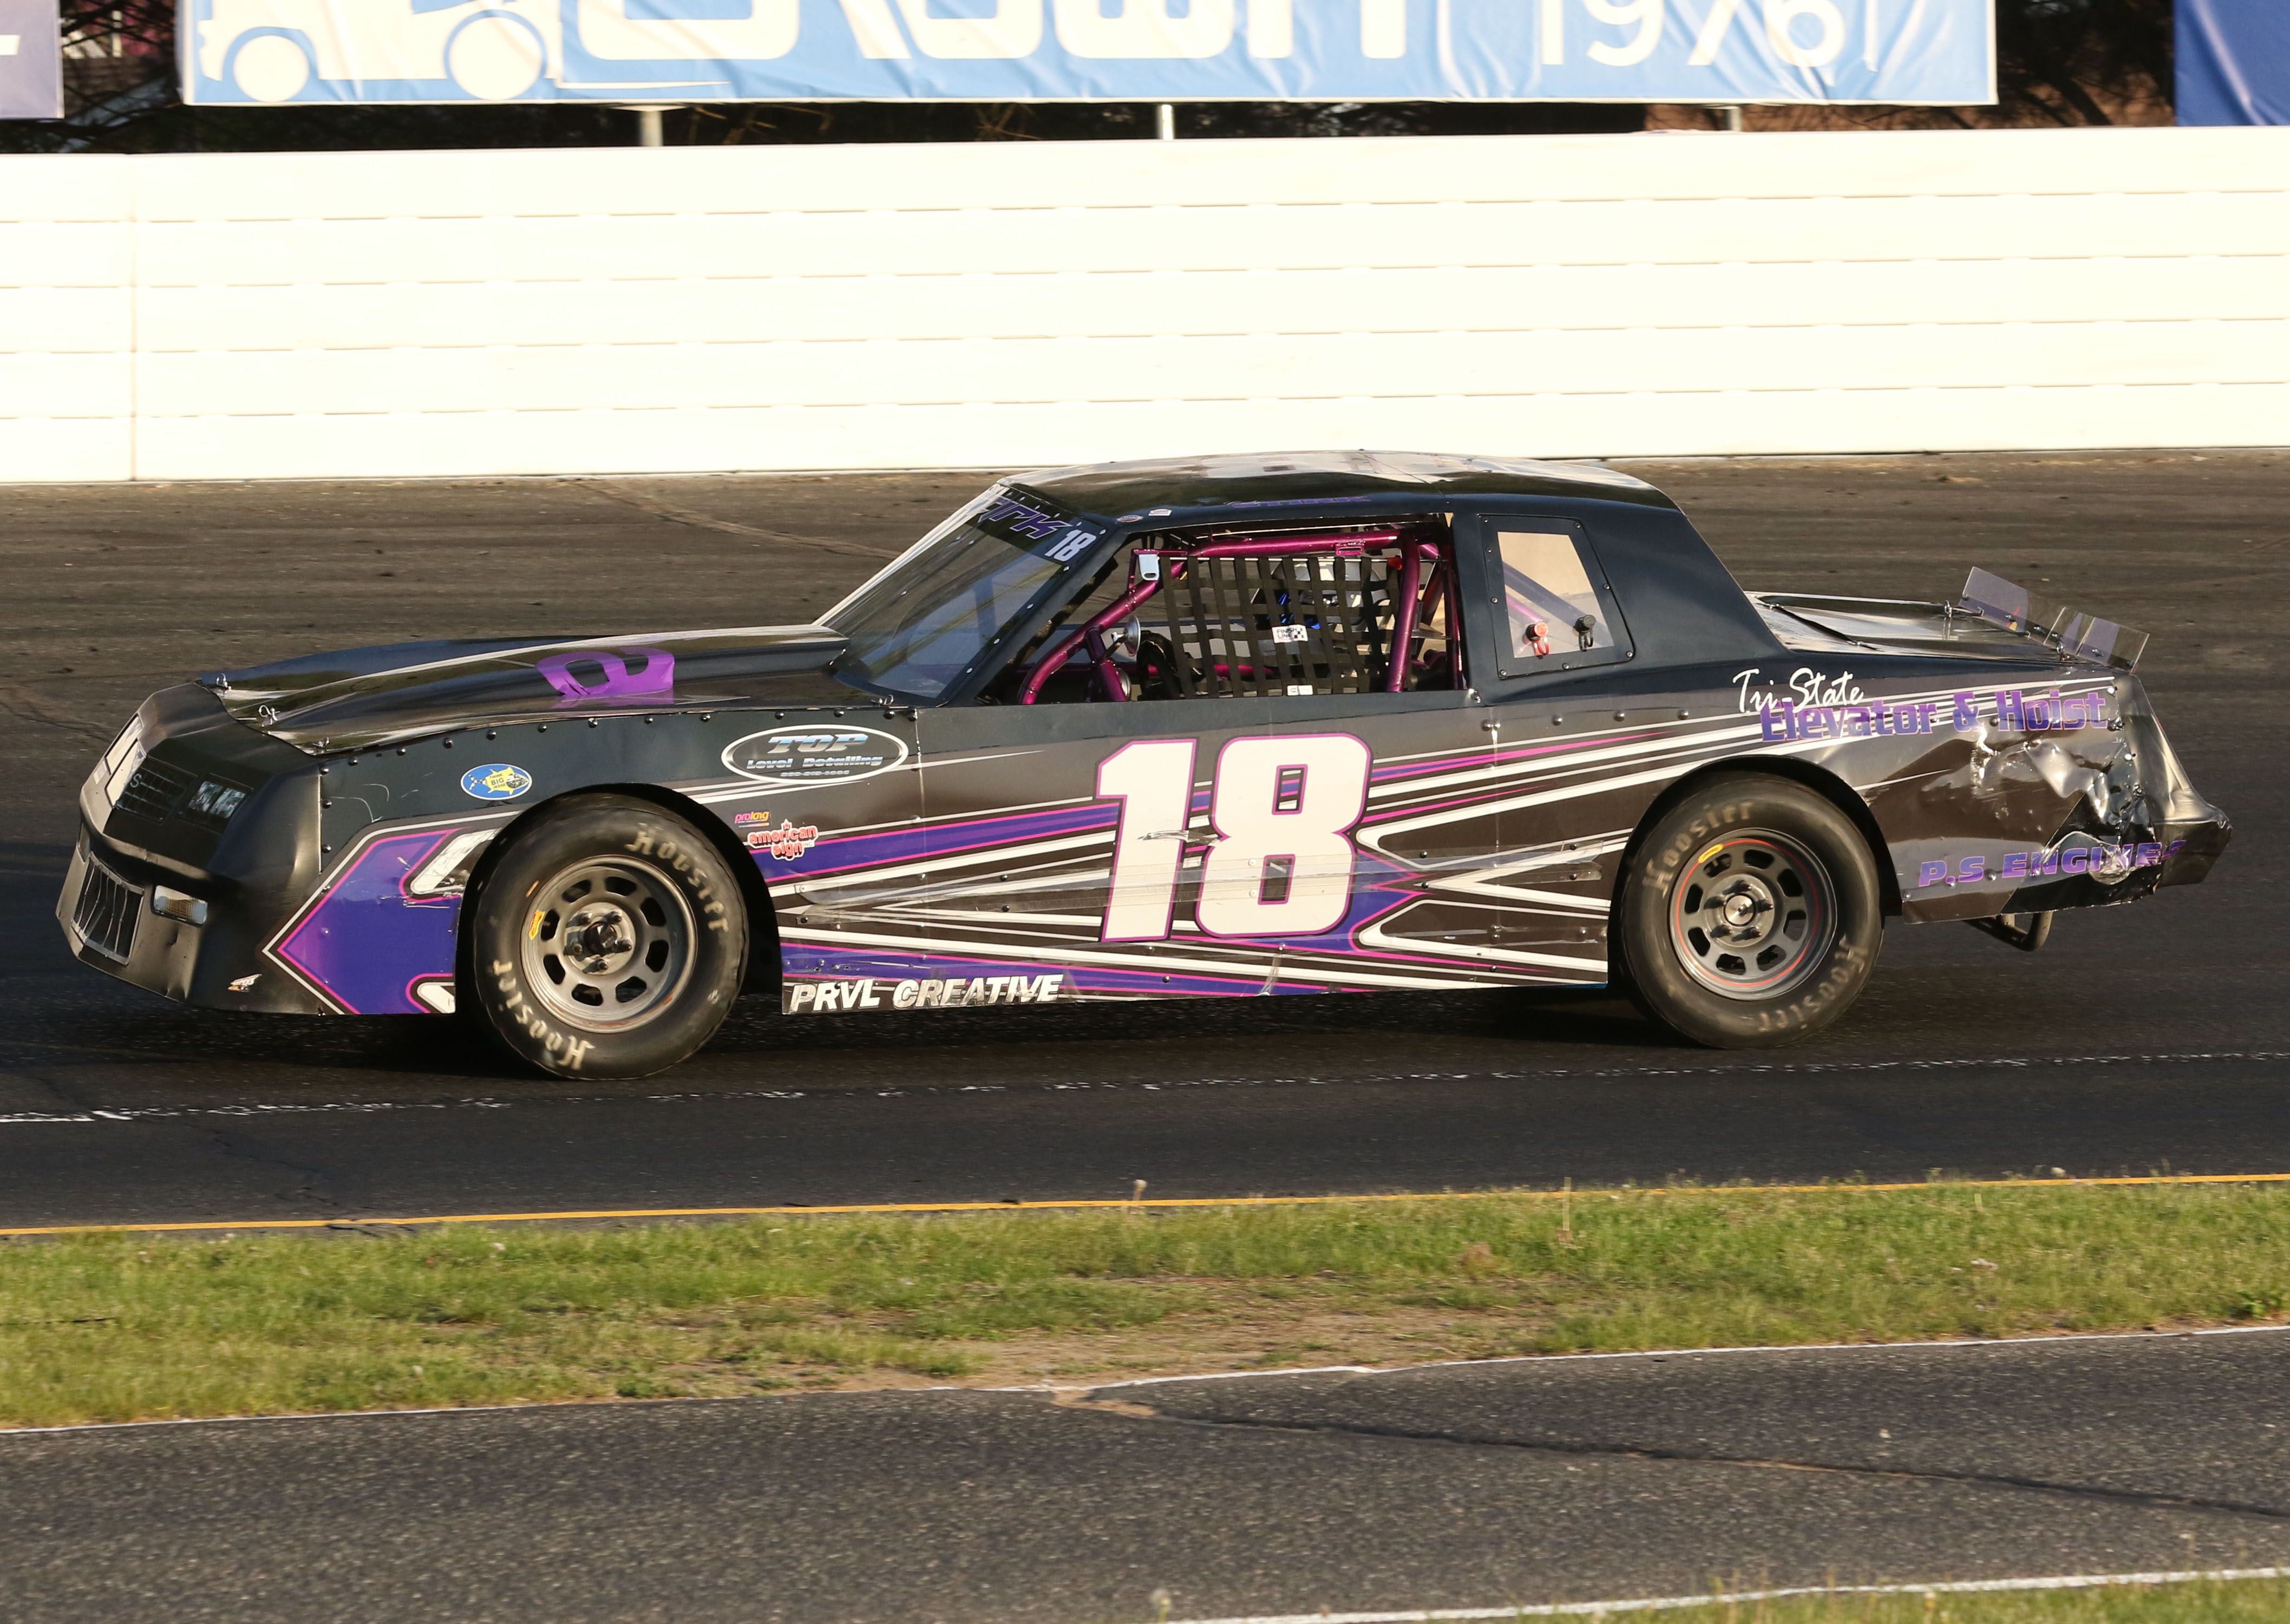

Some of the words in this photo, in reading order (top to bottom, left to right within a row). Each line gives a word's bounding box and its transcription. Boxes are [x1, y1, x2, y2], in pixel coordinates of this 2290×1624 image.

[1044, 529, 1097, 562] 18
[1733, 667, 1864, 713] Tri-State
[1760, 700, 1937, 742] Elevator
[1953, 691, 1985, 733] &
[1994, 690, 2109, 732] Hoist
[767, 734, 868, 754] TOP
[746, 758, 793, 769] Level
[802, 756, 884, 767] Detailing
[735, 811, 770, 823] prolong
[749, 826, 816, 846] american
[772, 841, 803, 857] sign
[1095, 734, 1372, 942] 18
[621, 822, 729, 933] Hoosier
[790, 979, 881, 1012] PRVL
[892, 974, 1064, 1010] CREATIVE
[493, 959, 596, 1071] Hoosier
